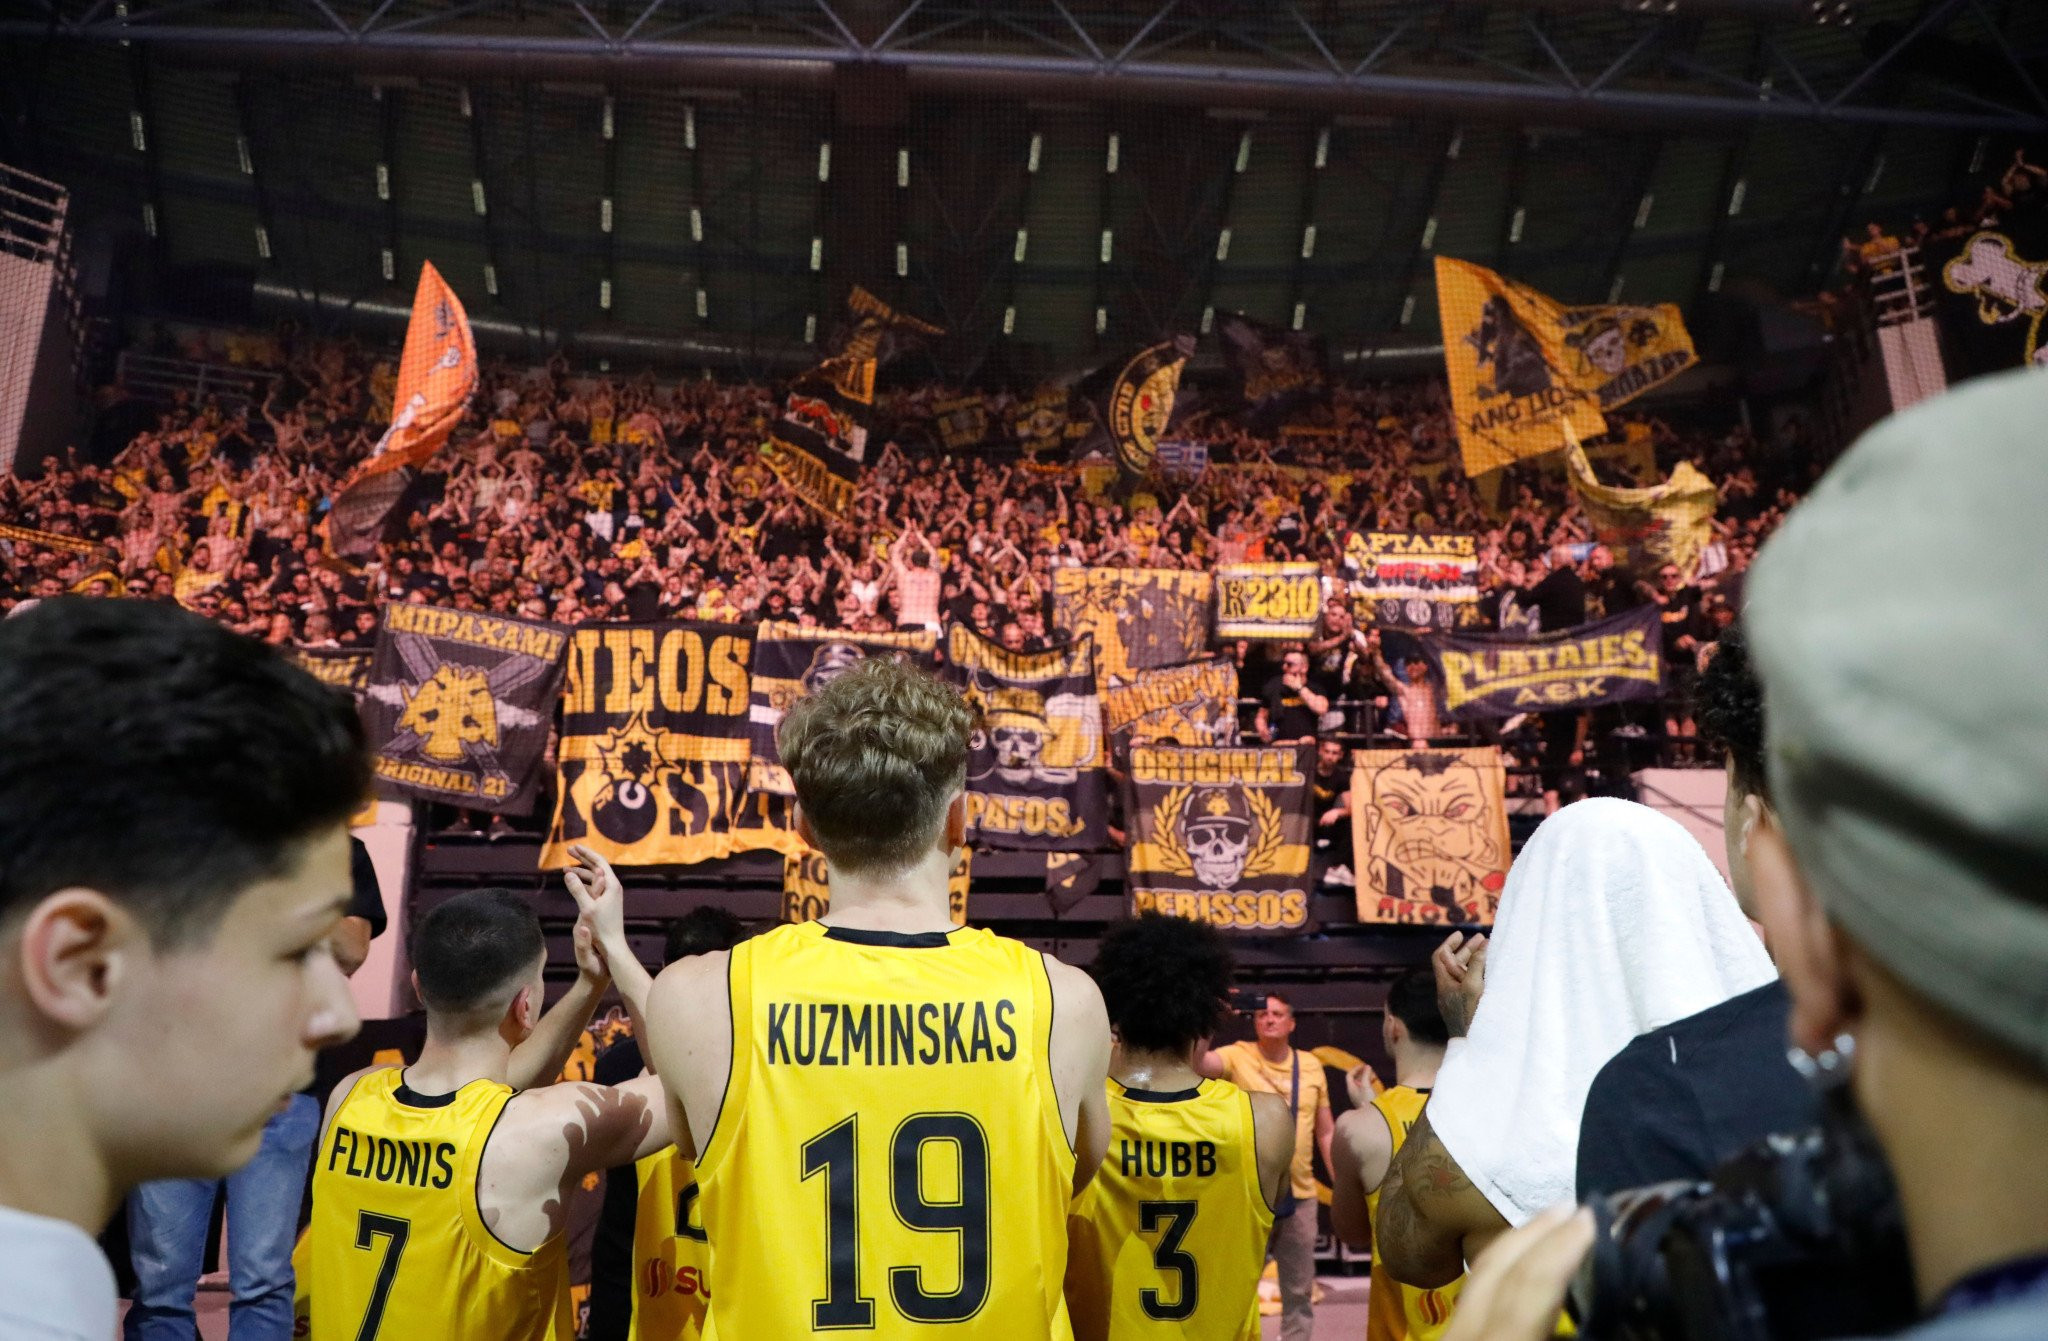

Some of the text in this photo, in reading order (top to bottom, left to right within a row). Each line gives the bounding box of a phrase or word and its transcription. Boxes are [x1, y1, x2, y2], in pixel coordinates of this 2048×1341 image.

[1054, 567, 1210, 602] SOUTH
[1441, 630, 1654, 709] PLATAIES
[484, 775, 508, 797] 21
[1134, 748, 1305, 784] ORIGINAL
[967, 794, 1072, 835] PAFOS
[1134, 890, 1306, 926] PERISSOS
[768, 999, 1017, 1066] KUZMINSKAS
[328, 1126, 456, 1190] FLIONIS
[1121, 1140, 1216, 1178] HUBB
[801, 1111, 992, 1332] 19
[354, 1209, 411, 1341] 7
[1139, 1200, 1198, 1321] 3
